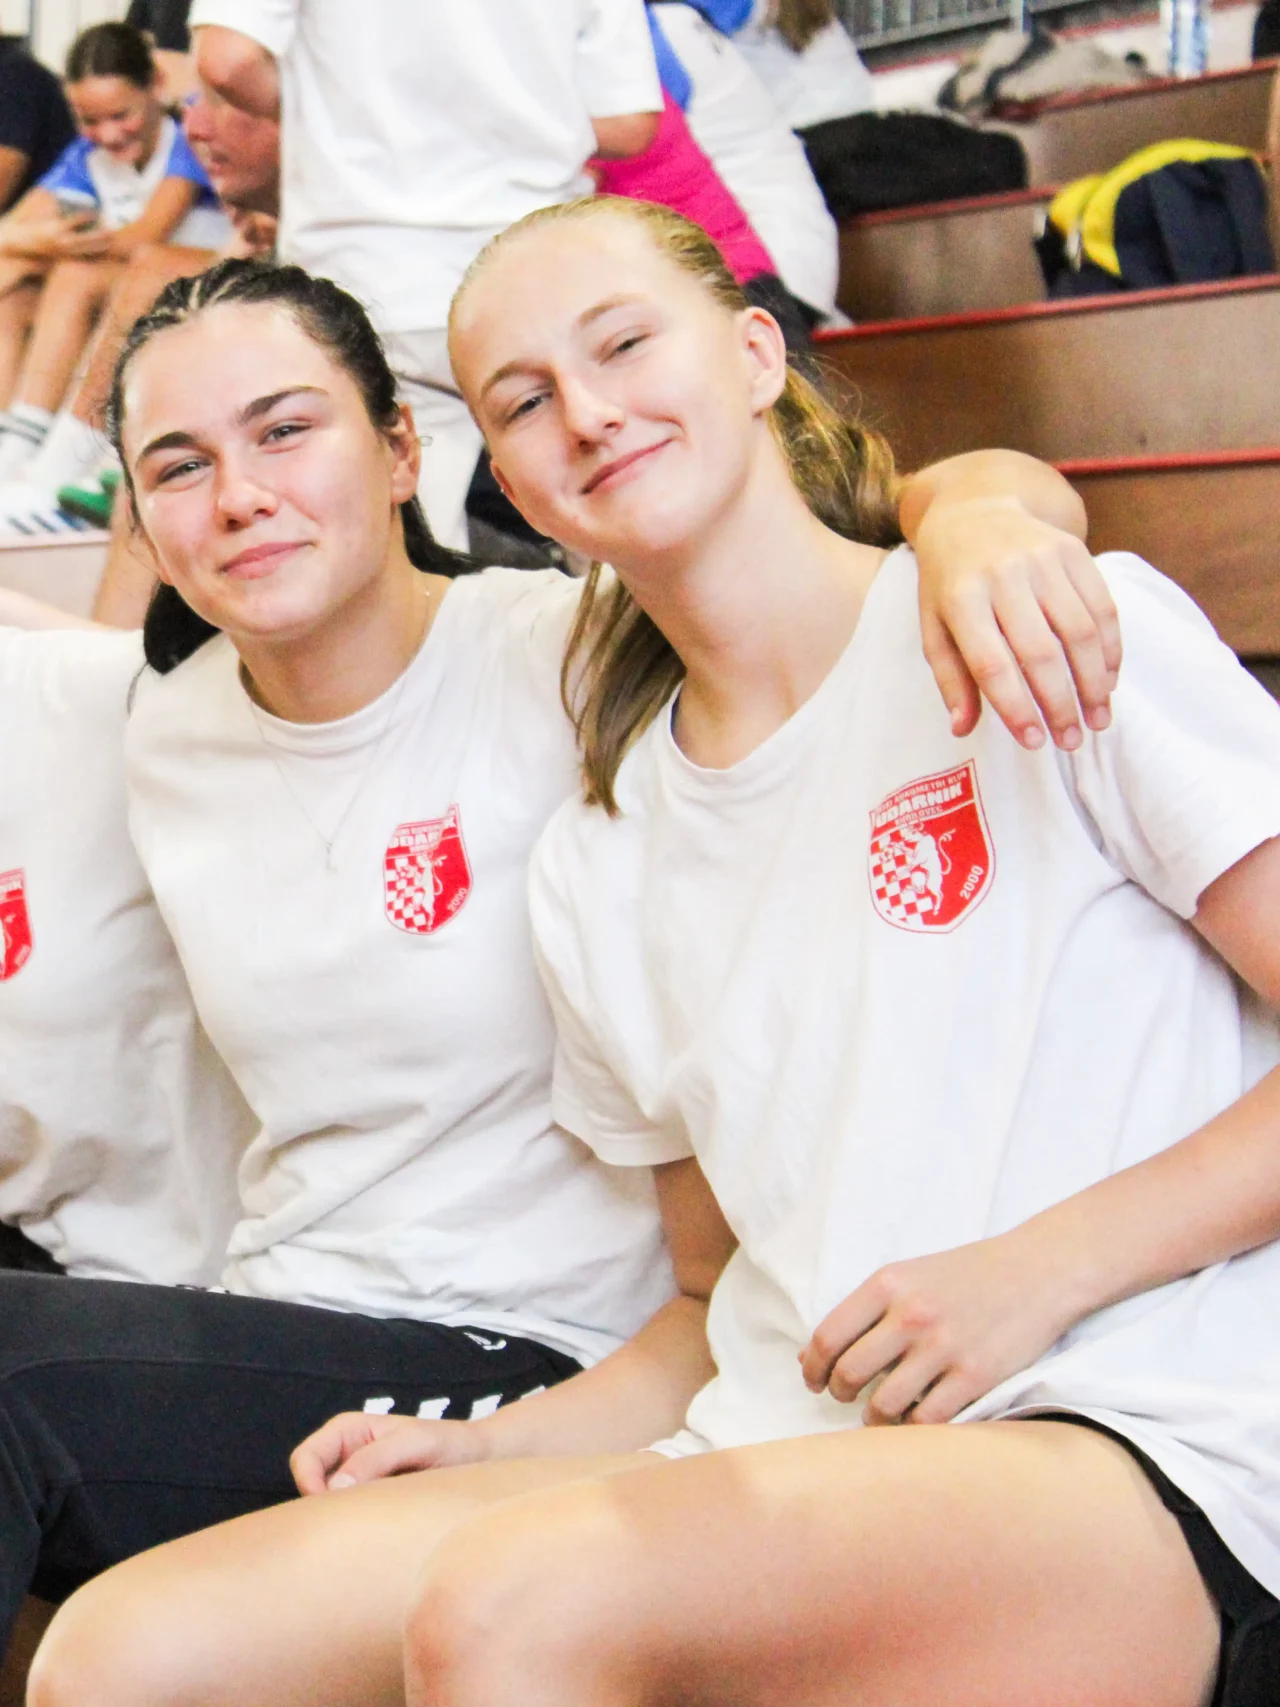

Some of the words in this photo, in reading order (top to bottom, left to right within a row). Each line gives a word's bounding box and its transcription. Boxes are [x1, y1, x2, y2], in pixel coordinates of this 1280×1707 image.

[874, 781, 963, 828] UDARNIK
[447, 887, 468, 912] 2000
[959, 864, 984, 900] 2000
